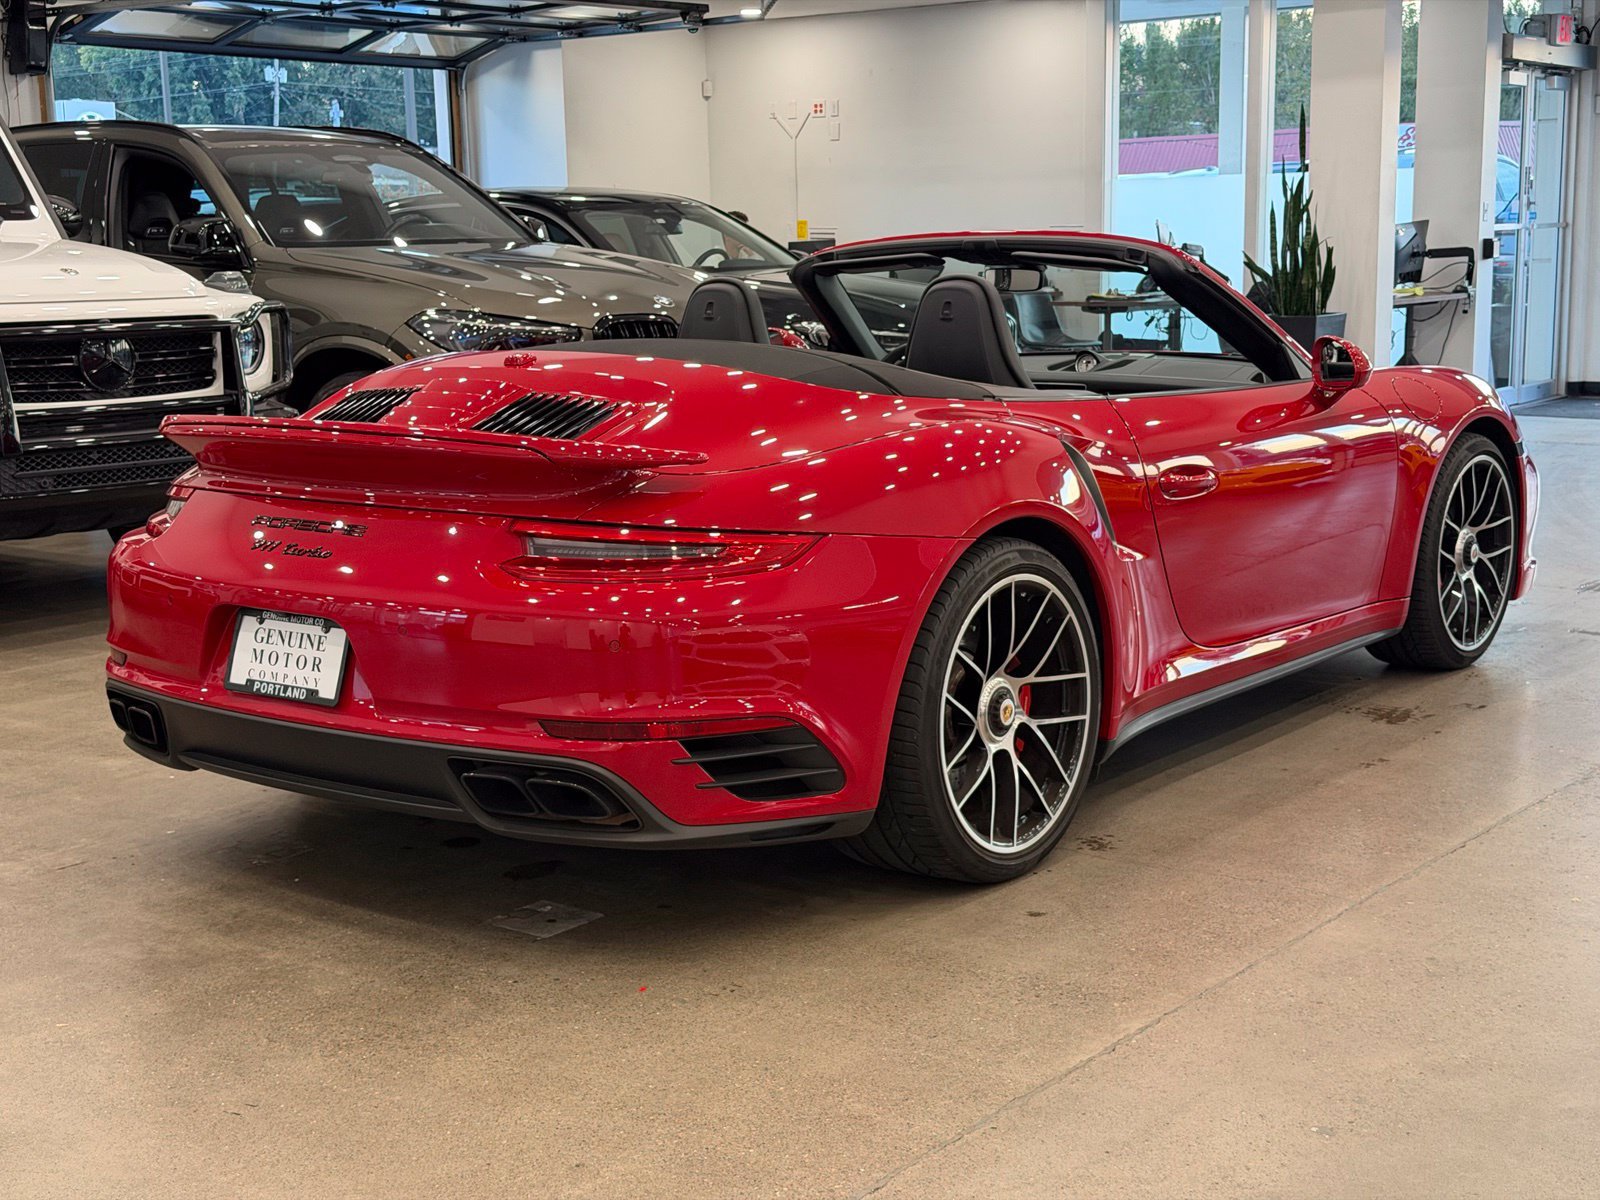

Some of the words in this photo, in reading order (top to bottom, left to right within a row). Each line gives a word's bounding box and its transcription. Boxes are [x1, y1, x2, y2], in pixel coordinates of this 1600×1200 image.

[251, 539, 282, 552] 911
[283, 543, 333, 559] turbo
[290, 615, 314, 625] MOTOR
[254, 626, 327, 653] GENUINE
[250, 647, 322, 673] MOTOR
[247, 667, 321, 688] COMPANY
[253, 681, 307, 700] PORTLAND
